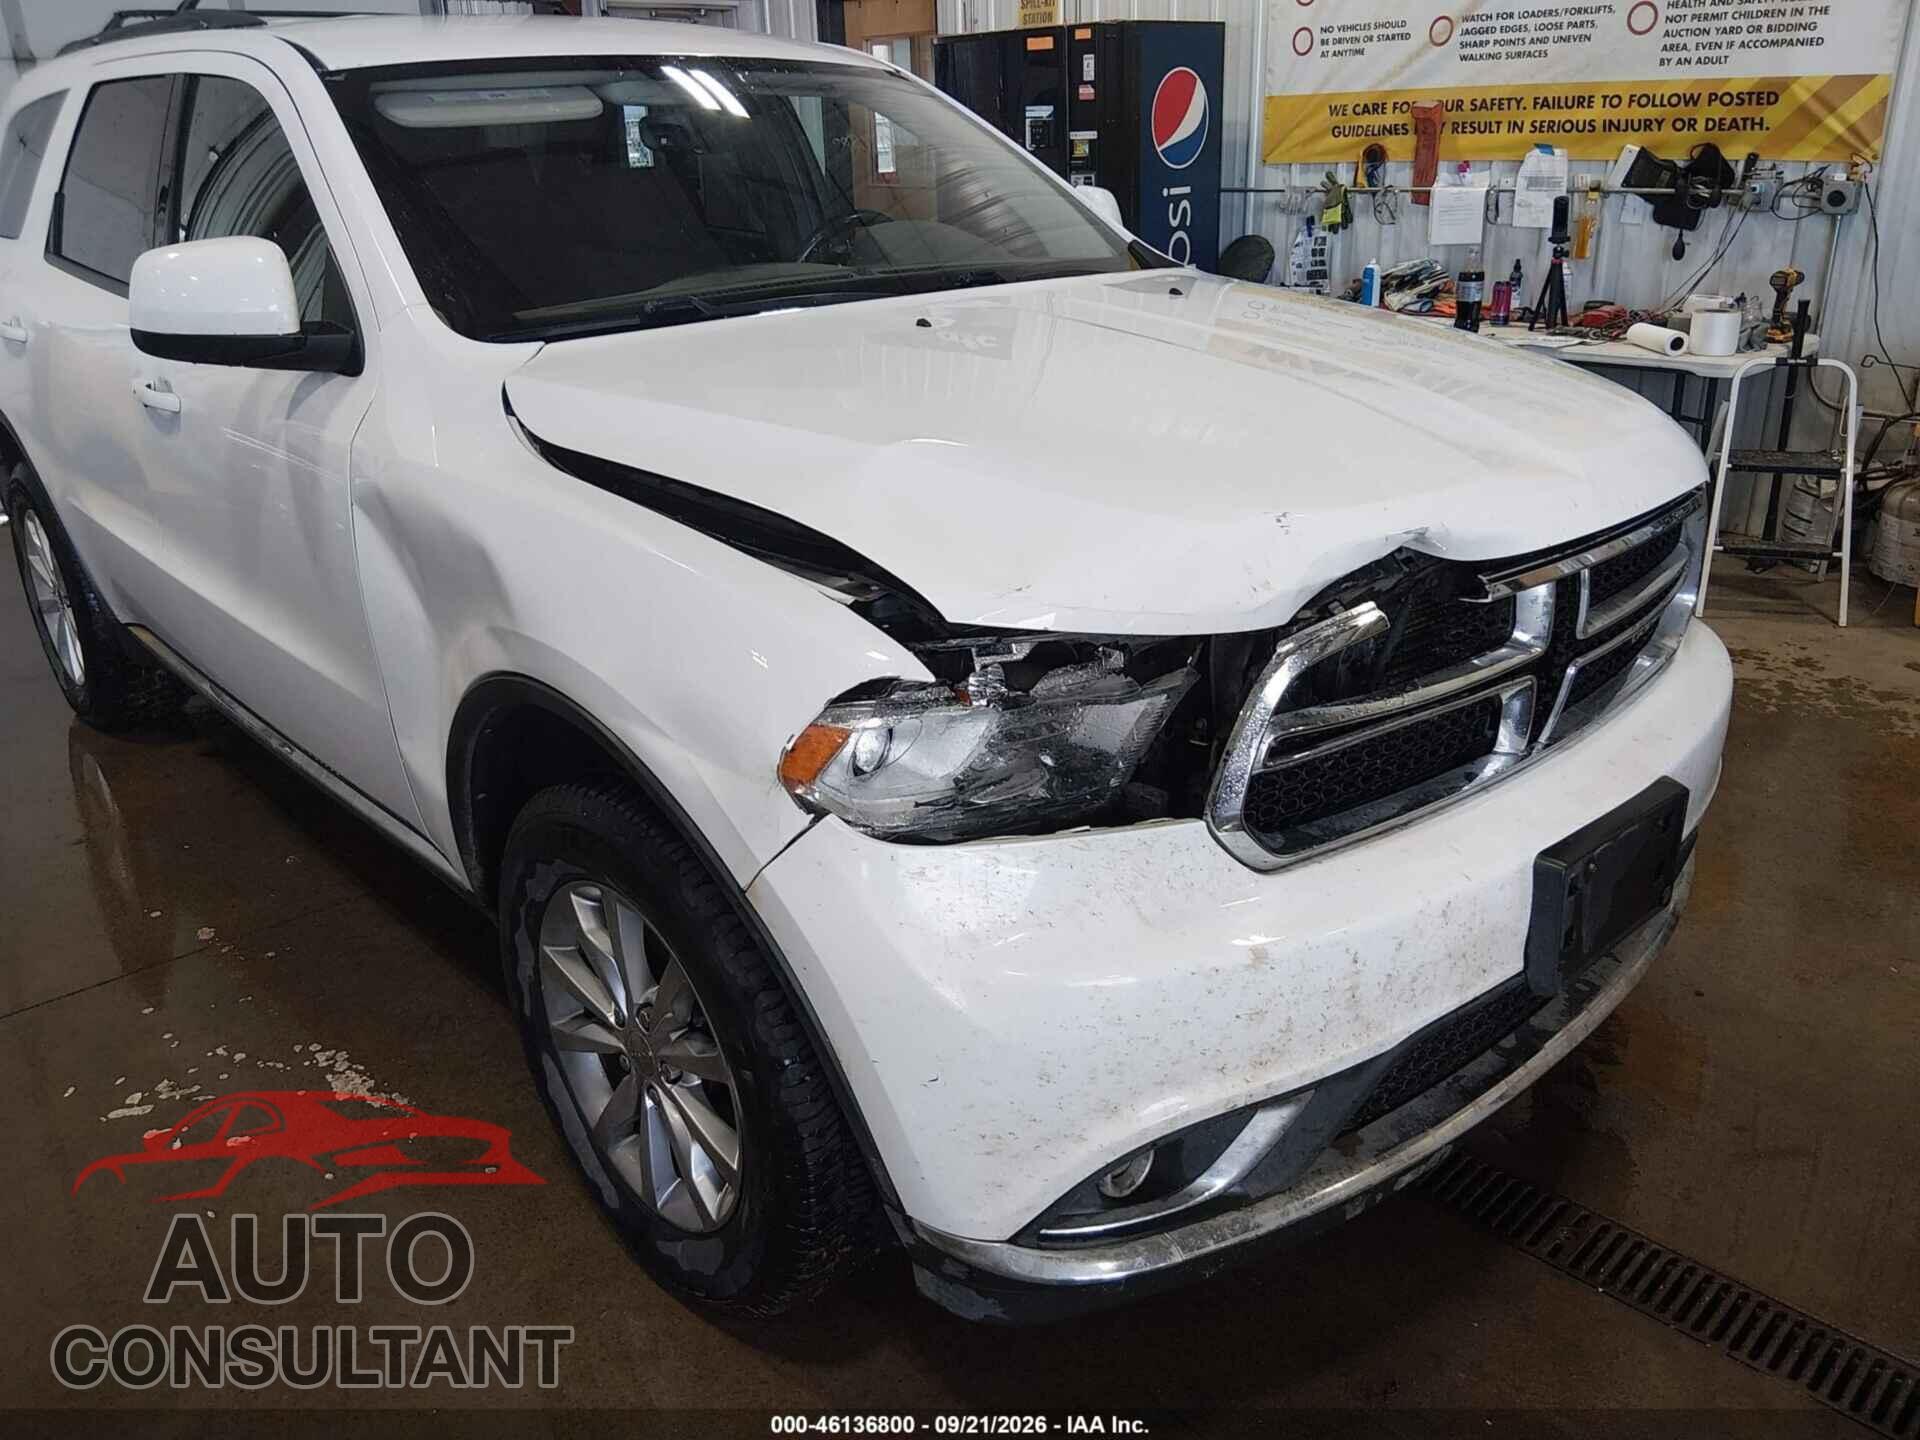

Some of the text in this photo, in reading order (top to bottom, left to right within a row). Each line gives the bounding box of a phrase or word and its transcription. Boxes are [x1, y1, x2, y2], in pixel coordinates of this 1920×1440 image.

[1666, 0, 1706, 10] HEALTH
[1461, 5, 1616, 23] WATCH FOR LOADERS/FORKLIFTS,
[1664, 5, 1831, 24] NOT PERMIT CHILDREN IN THE
[1320, 19, 1407, 34] NO VEHICLES SHOULD
[1459, 20, 1598, 37] JAGGED EDGES, LOOSE PARTS,
[1663, 21, 1818, 38] AUCTION YARD OR BIDDING
[1320, 32, 1411, 46] BE DRIVEN OR STARTED
[1459, 33, 1592, 50] SHARP POINTS AND UNEVEN
[1660, 36, 1825, 53] AREA, EVEN IF ACCOMPANIED
[1320, 47, 1365, 58] AT ANYTIME
[1459, 49, 1549, 62] WALKING SURFACES
[1658, 55, 1730, 67] BY AN ADULT
[1328, 103, 1349, 117] WE
[1352, 102, 1388, 116] CARE
[1392, 101, 1417, 115] FO
[1469, 97, 1527, 112] SAFETY.
[1532, 95, 1595, 111] FAILURE
[1601, 94, 1622, 109] TO
[1628, 92, 1702, 108] FOLLOW
[1707, 90, 1780, 107] POSTED
[1331, 123, 1409, 138] GUIDELINES
[1451, 120, 1504, 135] RESULT
[1507, 120, 1525, 134] IN
[1529, 118, 1597, 134] SERIOUS
[1602, 117, 1666, 133] INJURY
[1671, 117, 1697, 132] OR
[1704, 116, 1771, 132] DEATH.
